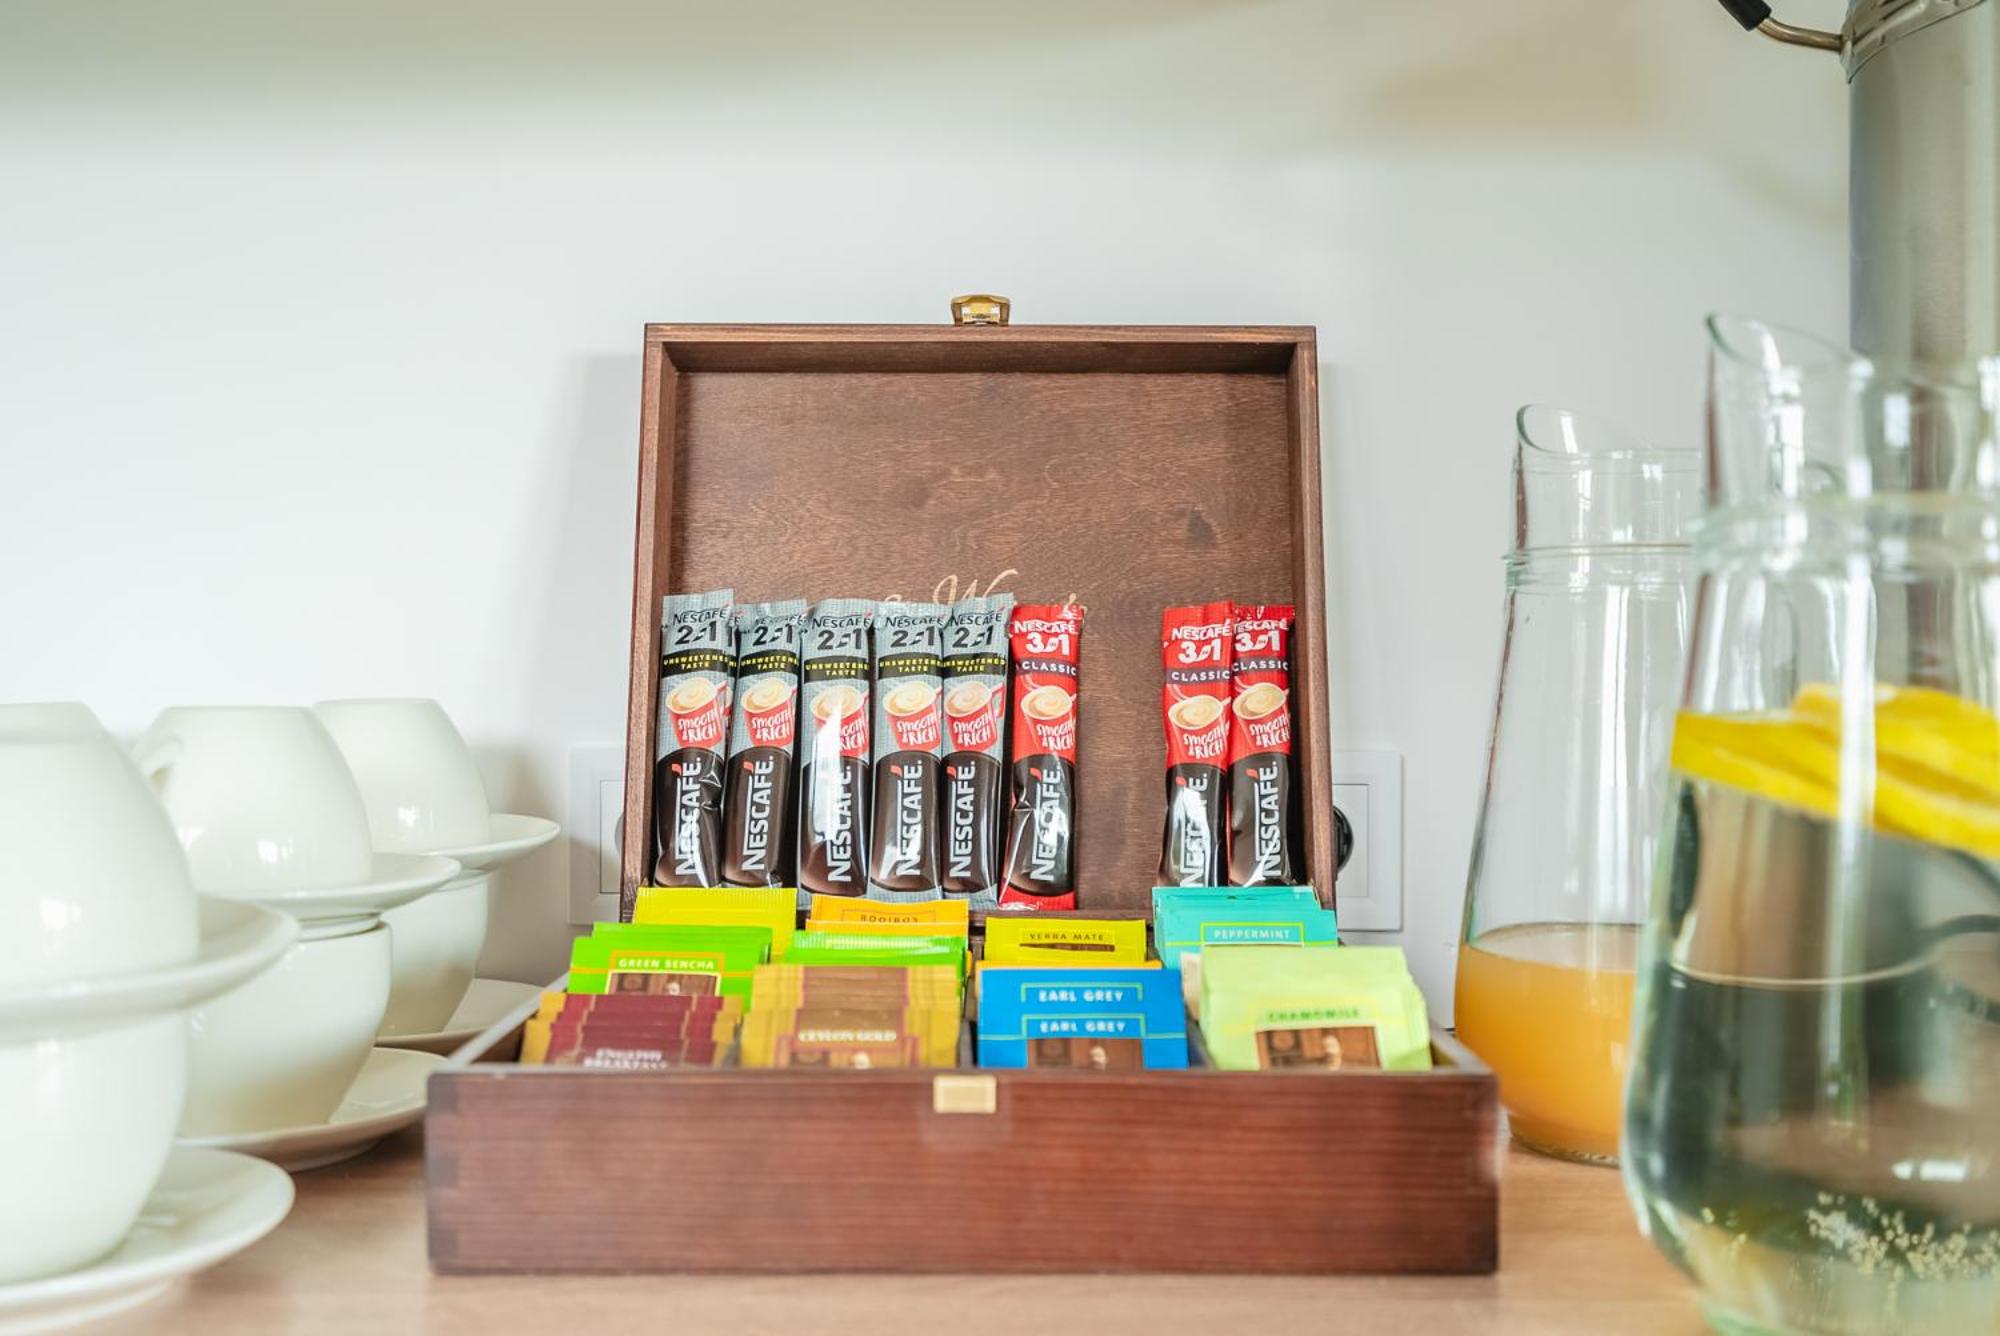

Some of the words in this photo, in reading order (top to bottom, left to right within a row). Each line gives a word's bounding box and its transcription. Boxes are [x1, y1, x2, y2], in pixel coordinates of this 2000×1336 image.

[1014, 619, 1079, 635] NESCAFÉ
[1171, 619, 1231, 640] NESCAFÉ
[1234, 618, 1288, 634] ESCAFÉ
[681, 661, 710, 670] TASTE
[741, 655, 798, 666] UNSWEETENE
[757, 662, 785, 670] TASTE
[805, 662, 869, 670] UNSWEETENE
[1232, 660, 1289, 671] CLASSIC
[1022, 660, 1077, 675] CLASSIC
[1171, 669, 1231, 682] CLASSIC
[1073, 933, 1104, 941] MATE
[1214, 929, 1289, 939] PEPPERMINT
[618, 959, 660, 968] GREEN
[664, 960, 714, 970] SENCHA
[1039, 989, 1077, 1002] EARL
[1083, 989, 1123, 1002] GREY
[1040, 1020, 1078, 1033] EARL
[1085, 1020, 1126, 1032] GREY
